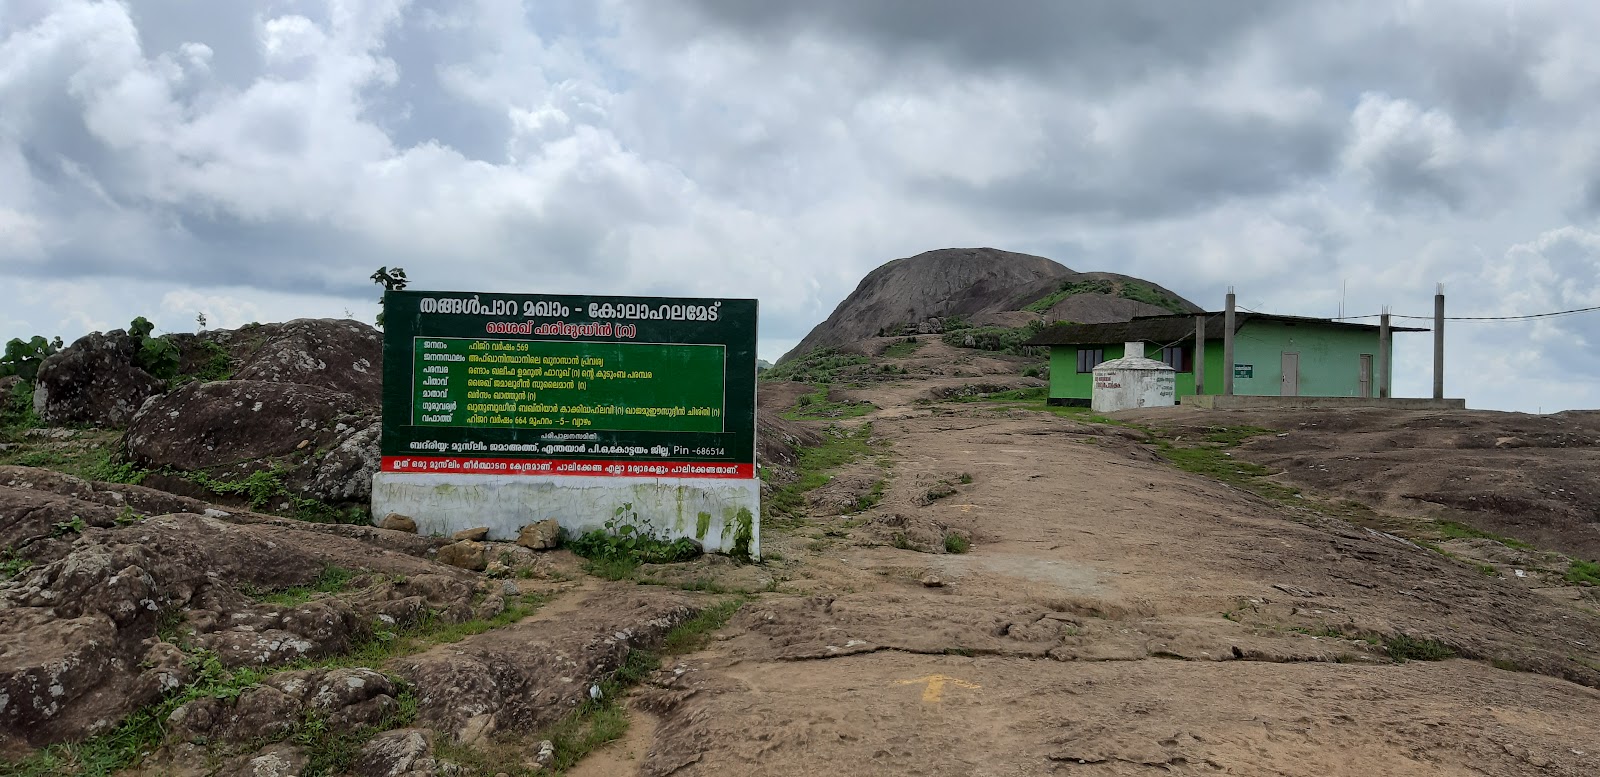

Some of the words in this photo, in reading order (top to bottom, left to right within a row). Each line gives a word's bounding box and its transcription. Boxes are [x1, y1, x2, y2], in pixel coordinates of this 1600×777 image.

[523, 300, 569, 317] മഖാം
[588, 301, 721, 320] കോലാഹലമേട്
[486, 320, 534, 334] ശൈഖ്
[615, 323, 636, 338] (റ)
[492, 341, 515, 350] വർഷം
[516, 343, 529, 351] 569
[424, 353, 465, 361] ജനനസ്ഥലം
[596, 370, 626, 380] കുടുംബ
[423, 376, 449, 385] പിതാവ്
[532, 380, 574, 390] സുലൈമാൻ
[423, 388, 448, 397] മാതാവ്
[422, 413, 453, 422] വഫാത്ത്
[490, 415, 512, 424] വർഷം
[572, 418, 591, 427] വ്യാഴം
[674, 446, 689, 454] Pin
[394, 459, 411, 469] ഇത്
[412, 461, 427, 469] ഒരു
[557, 462, 602, 471] പാലിക്കേണ്ട
[605, 465, 624, 474] എല്ലാ
